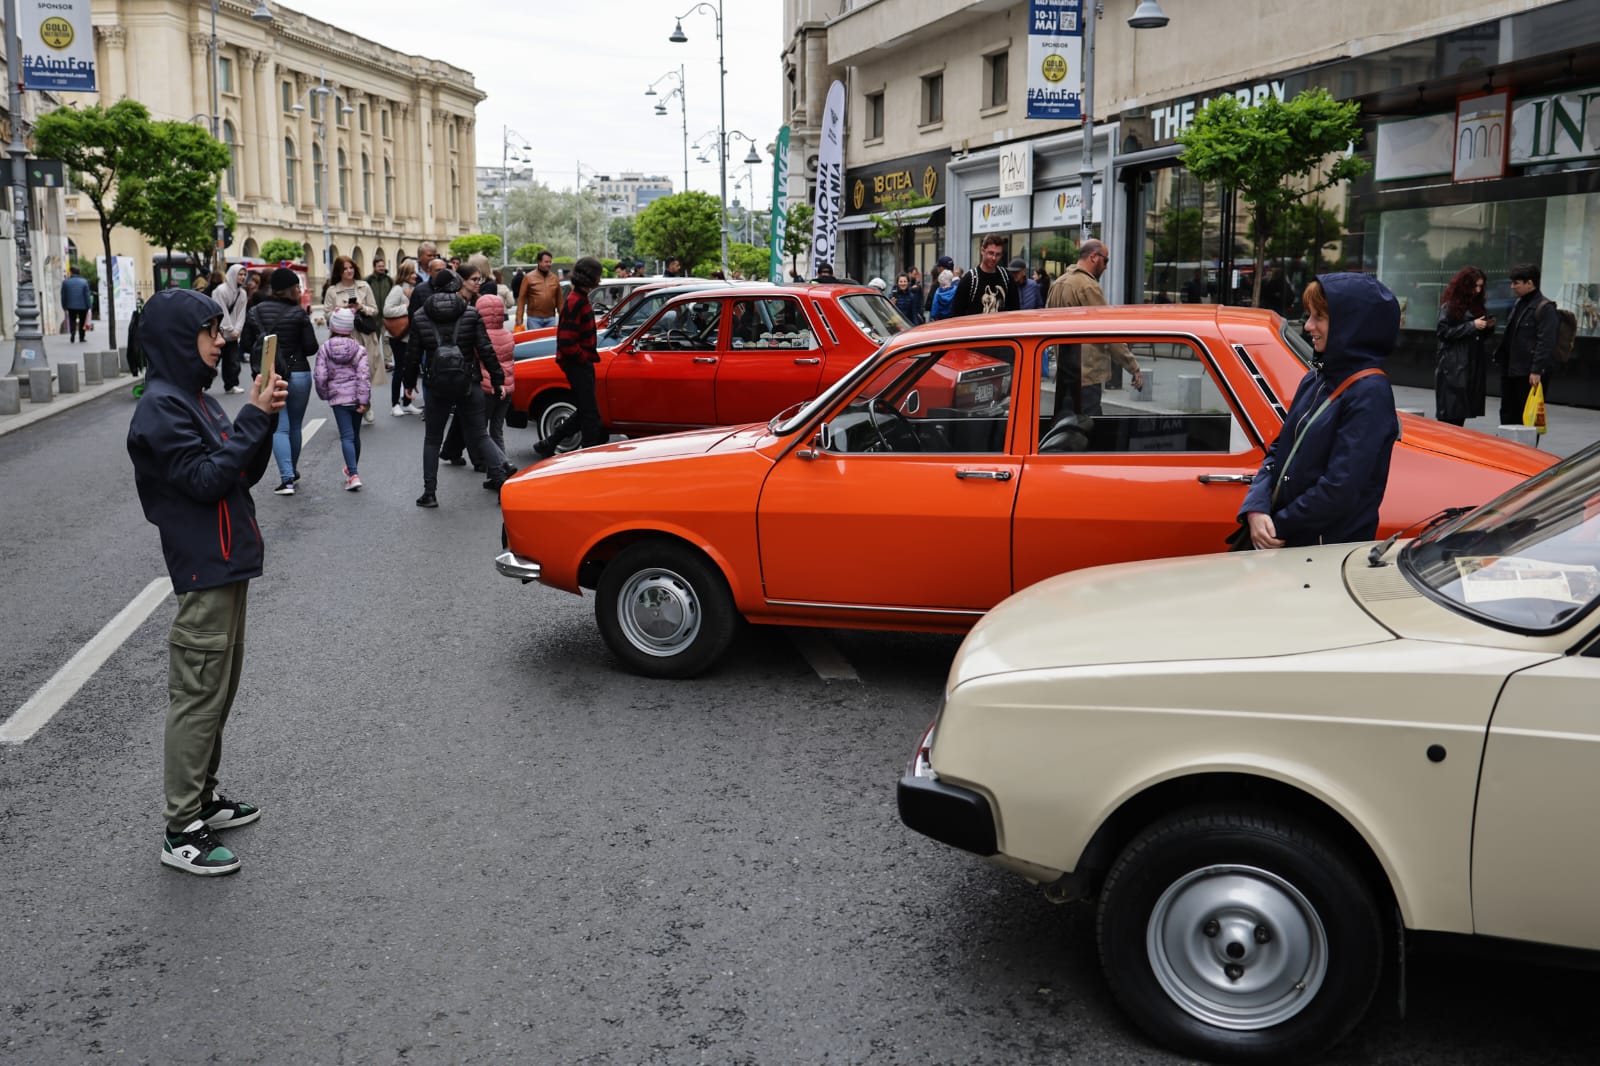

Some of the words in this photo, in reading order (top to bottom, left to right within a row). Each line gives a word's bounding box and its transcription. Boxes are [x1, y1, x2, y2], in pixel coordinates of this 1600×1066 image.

[38, 2, 73, 10] SPONSOR
[1035, 10, 1057, 20] 10-11
[45, 23, 68, 32] GOLD
[1035, 20, 1057, 30] MAI
[22, 54, 95, 71] #AimFar
[1027, 87, 1081, 100] #AimFar
[1151, 100, 1196, 142] THE
[1528, 92, 1600, 158] IN
[1001, 151, 1026, 180] PAM
[775, 140, 789, 263] GRAWE
[991, 202, 1014, 217] ROMANIA
